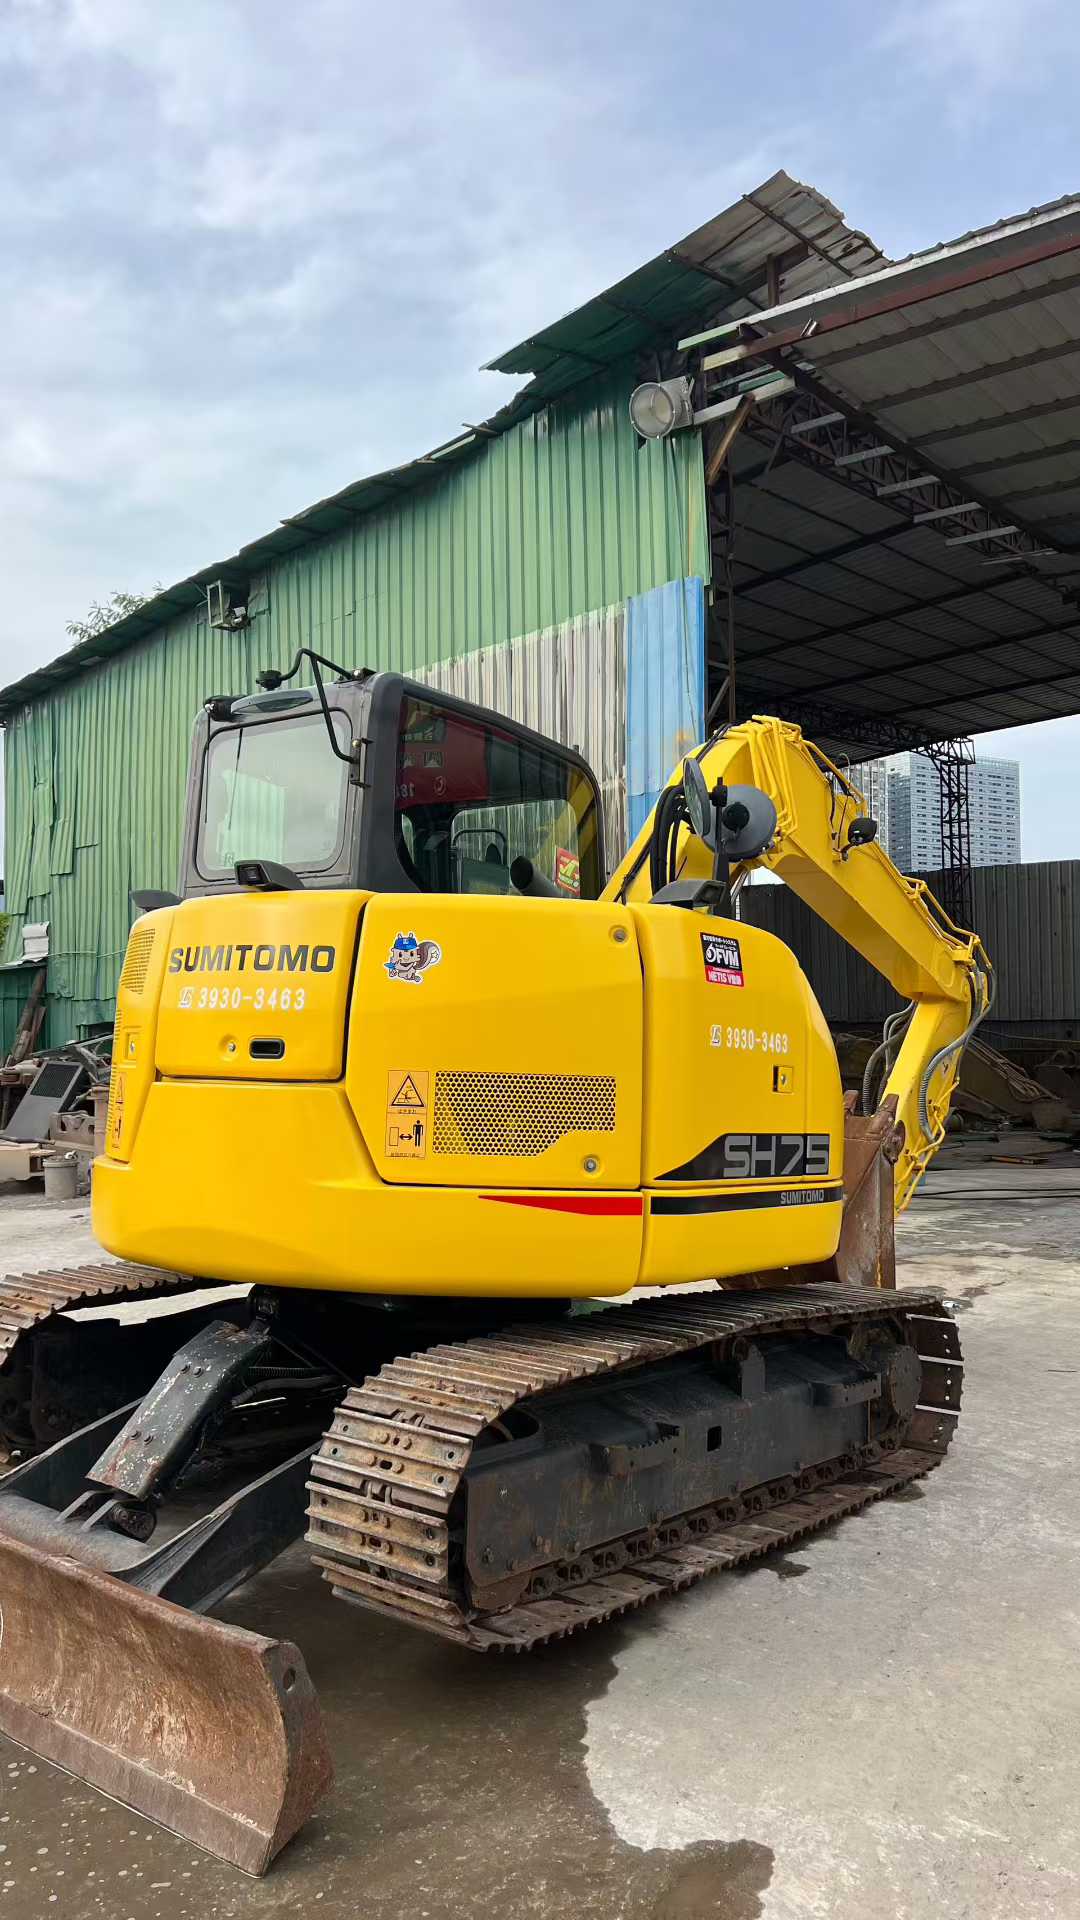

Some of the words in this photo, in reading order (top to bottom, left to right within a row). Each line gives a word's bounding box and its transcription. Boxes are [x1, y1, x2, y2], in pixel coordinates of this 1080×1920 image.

[169, 945, 336, 972] SUMITOMO
[716, 948, 740, 967] FVM
[198, 987, 306, 1010] 3930-3463
[726, 1026, 789, 1054] 3930-3463
[723, 1135, 829, 1177] SH75
[780, 1190, 825, 1205] SUMITOMO
